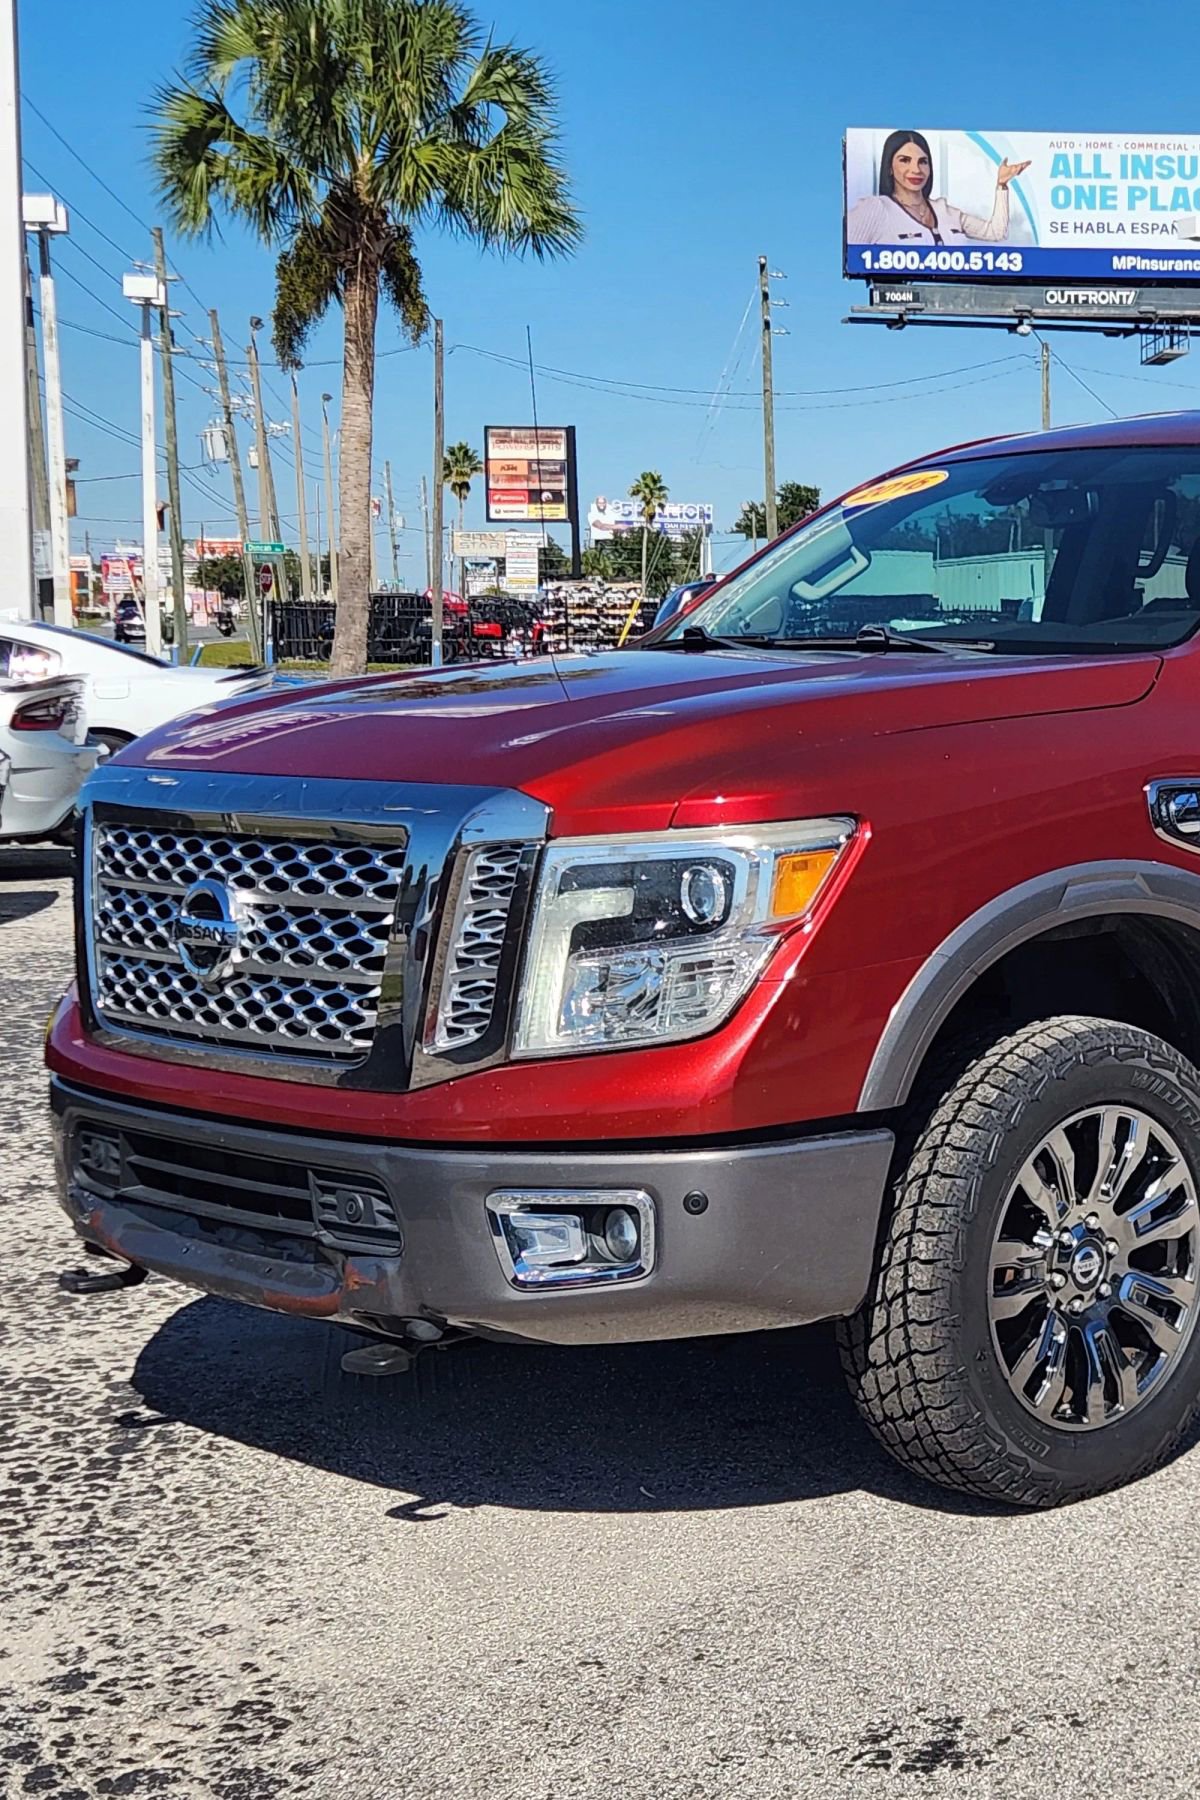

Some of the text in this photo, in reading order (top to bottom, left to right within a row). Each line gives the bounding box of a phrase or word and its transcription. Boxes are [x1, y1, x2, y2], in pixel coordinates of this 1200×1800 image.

[1049, 141, 1075, 149] AUTO
[1085, 141, 1113, 150] HOME
[1124, 142, 1188, 151] COMMERCIAL
[1049, 153, 1112, 179] ALL
[1050, 184, 1118, 211] ONE
[1049, 220, 1179, 235] SE HABLA ESPAÑ
[861, 250, 1023, 272] 1.800.400.5143
[885, 291, 913, 301] 7004N
